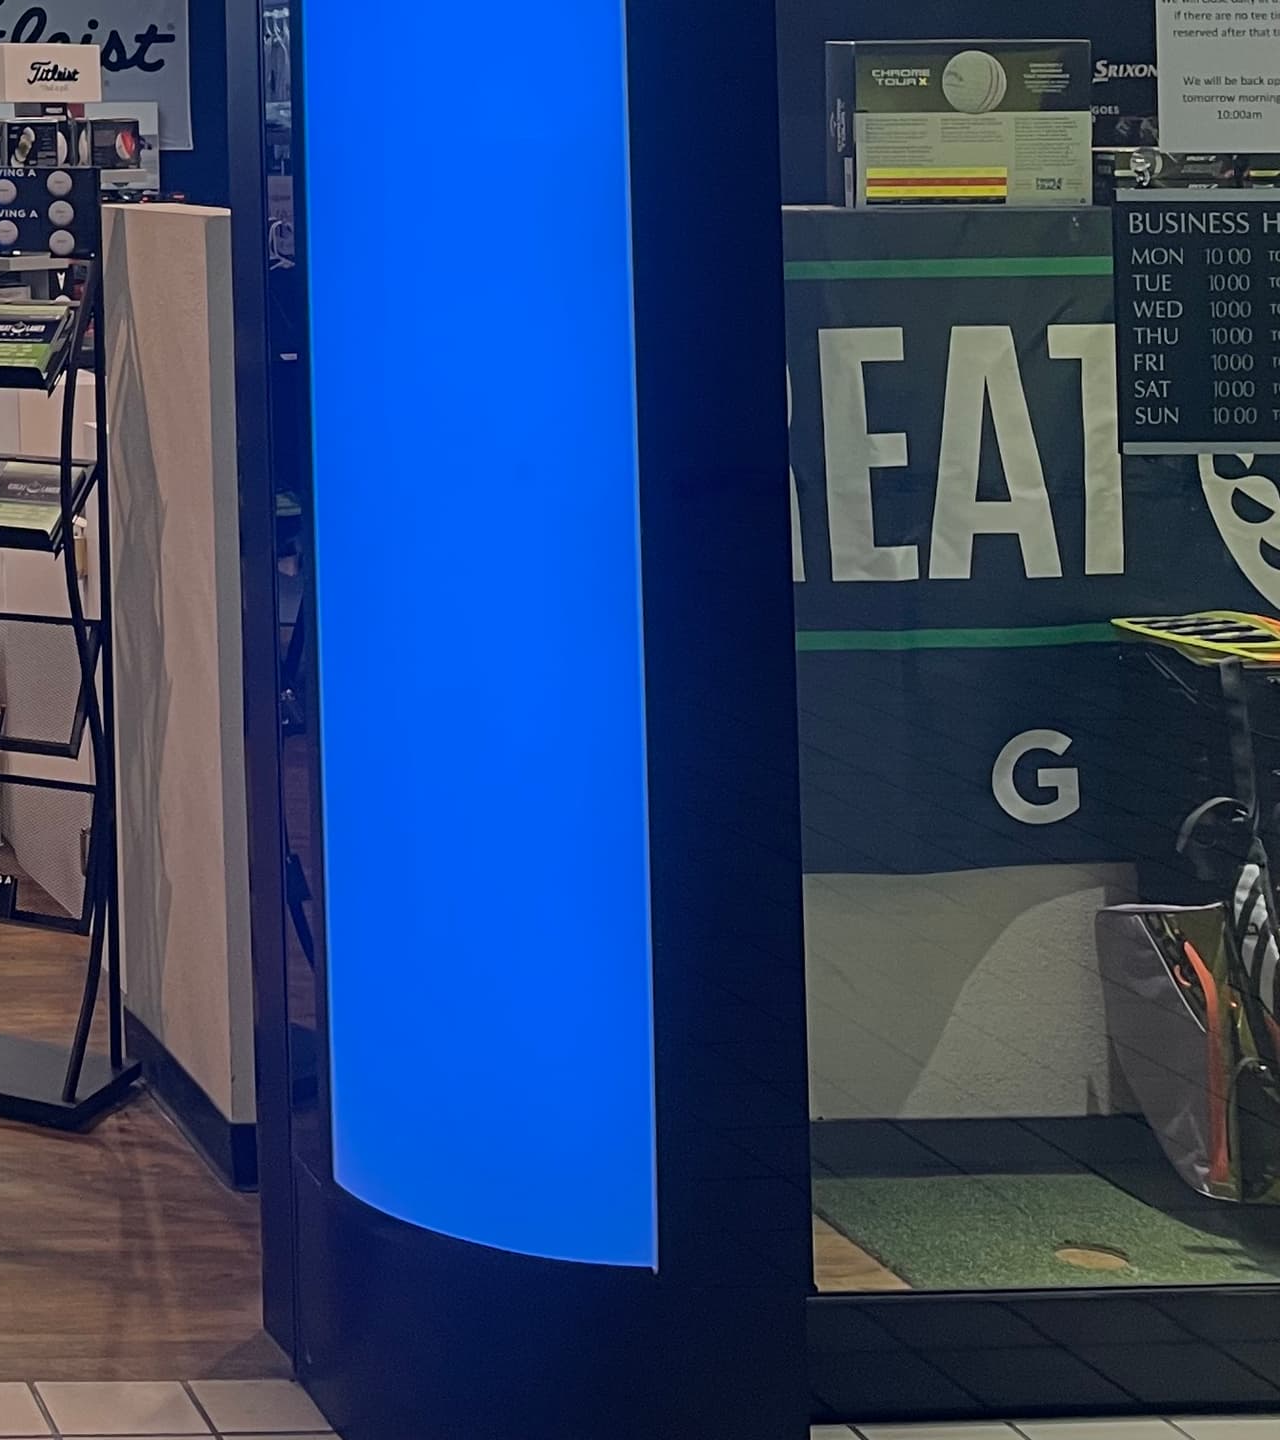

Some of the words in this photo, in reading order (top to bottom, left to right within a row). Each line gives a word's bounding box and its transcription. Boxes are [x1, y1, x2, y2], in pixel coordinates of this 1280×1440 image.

[1174, 11, 1182, 20] if
[1184, 11, 1212, 20] there
[1215, 12, 1232, 20] are
[1234, 12, 1248, 20] no
[1251, 11, 1268, 20] tee
[1173, 28, 1219, 37] reserved
[1221, 27, 1246, 37] after
[1249, 28, 1268, 37] that
[27, 61, 80, 85] Titleist
[871, 69, 930, 77] CHROME
[1092, 60, 1158, 83] SRIXON
[1183, 75, 1201, 85] We
[1203, 75, 1221, 85] will
[1224, 75, 1238, 85] be
[1240, 75, 1264, 85] back
[875, 78, 917, 86] TOUR
[918, 77, 928, 86] X
[1182, 94, 1235, 103] tomorrow
[1217, 110, 1263, 120] 10:00am
[27, 169, 37, 177] A
[29, 210, 38, 218] A
[1129, 212, 1250, 235] BUSINESS
[1131, 247, 1184, 265] MON
[1132, 274, 1172, 292] TUE
[1133, 300, 1183, 318] WED
[1133, 327, 1179, 345] THU
[1134, 354, 1165, 371] FRI
[1134, 380, 1171, 398] SAT
[1135, 407, 1180, 425] SUN
[787, 324, 1125, 582] EAT
[4, 875, 13, 885] A
